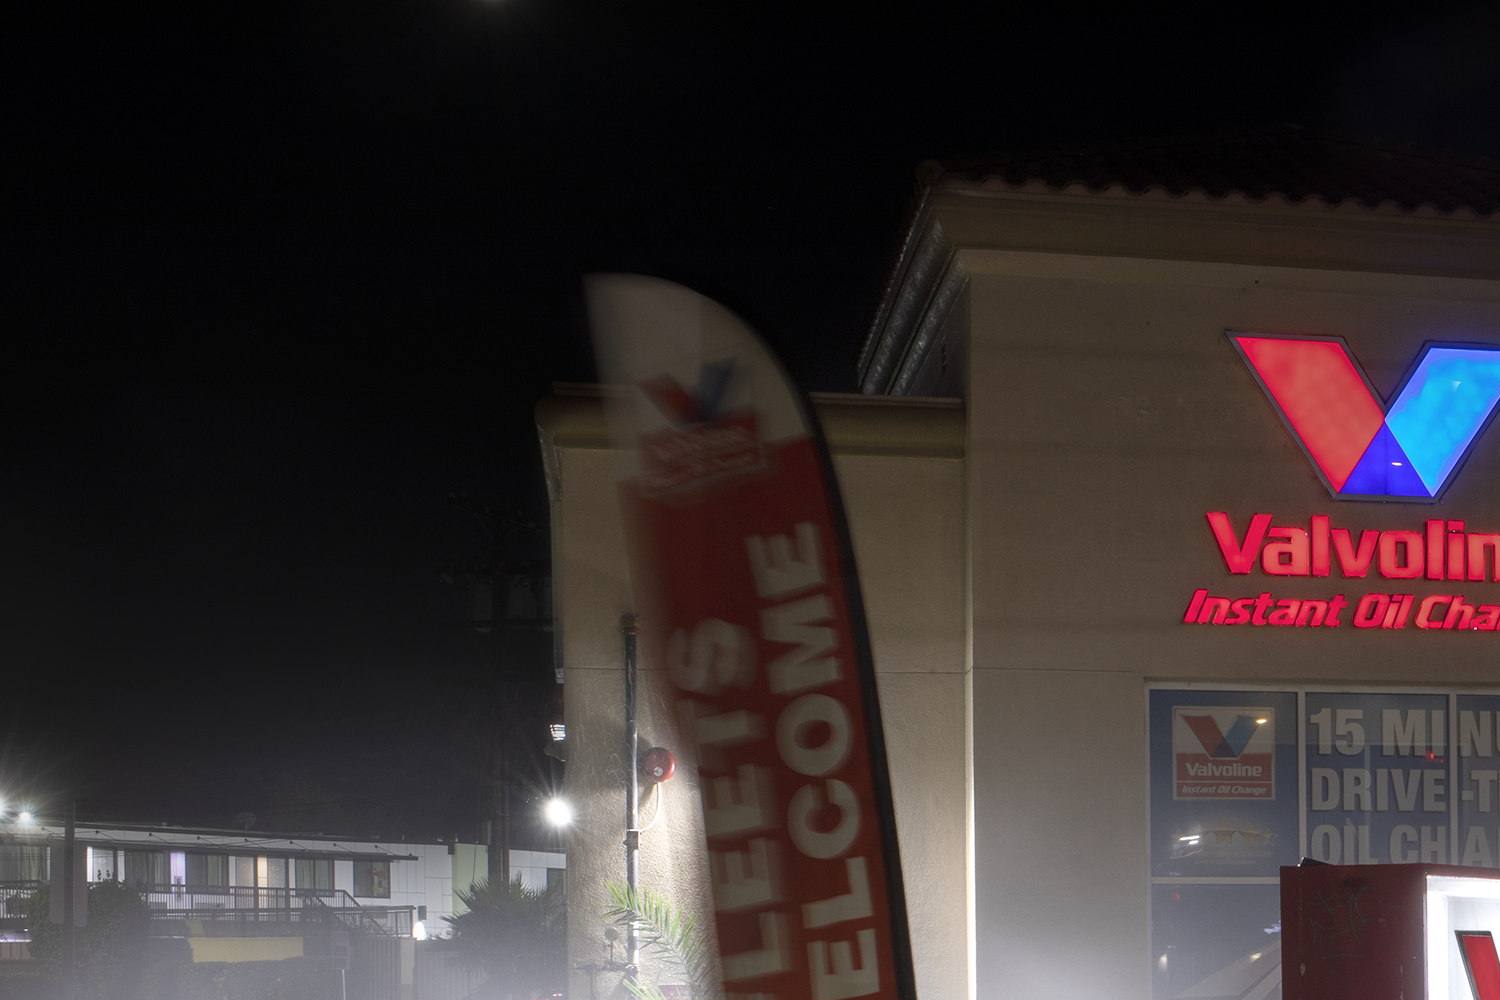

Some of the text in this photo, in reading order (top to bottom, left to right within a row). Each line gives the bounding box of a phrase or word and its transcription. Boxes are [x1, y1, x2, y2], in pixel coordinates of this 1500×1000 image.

[1183, 589, 1348, 628] Instant
[1353, 592, 1415, 630] Oil
[1309, 707, 1366, 757] 15
[1182, 785, 1267, 796] Instant Oil Change
[1185, 763, 1262, 777] Valvoline
[1310, 824, 1379, 865] OIL
